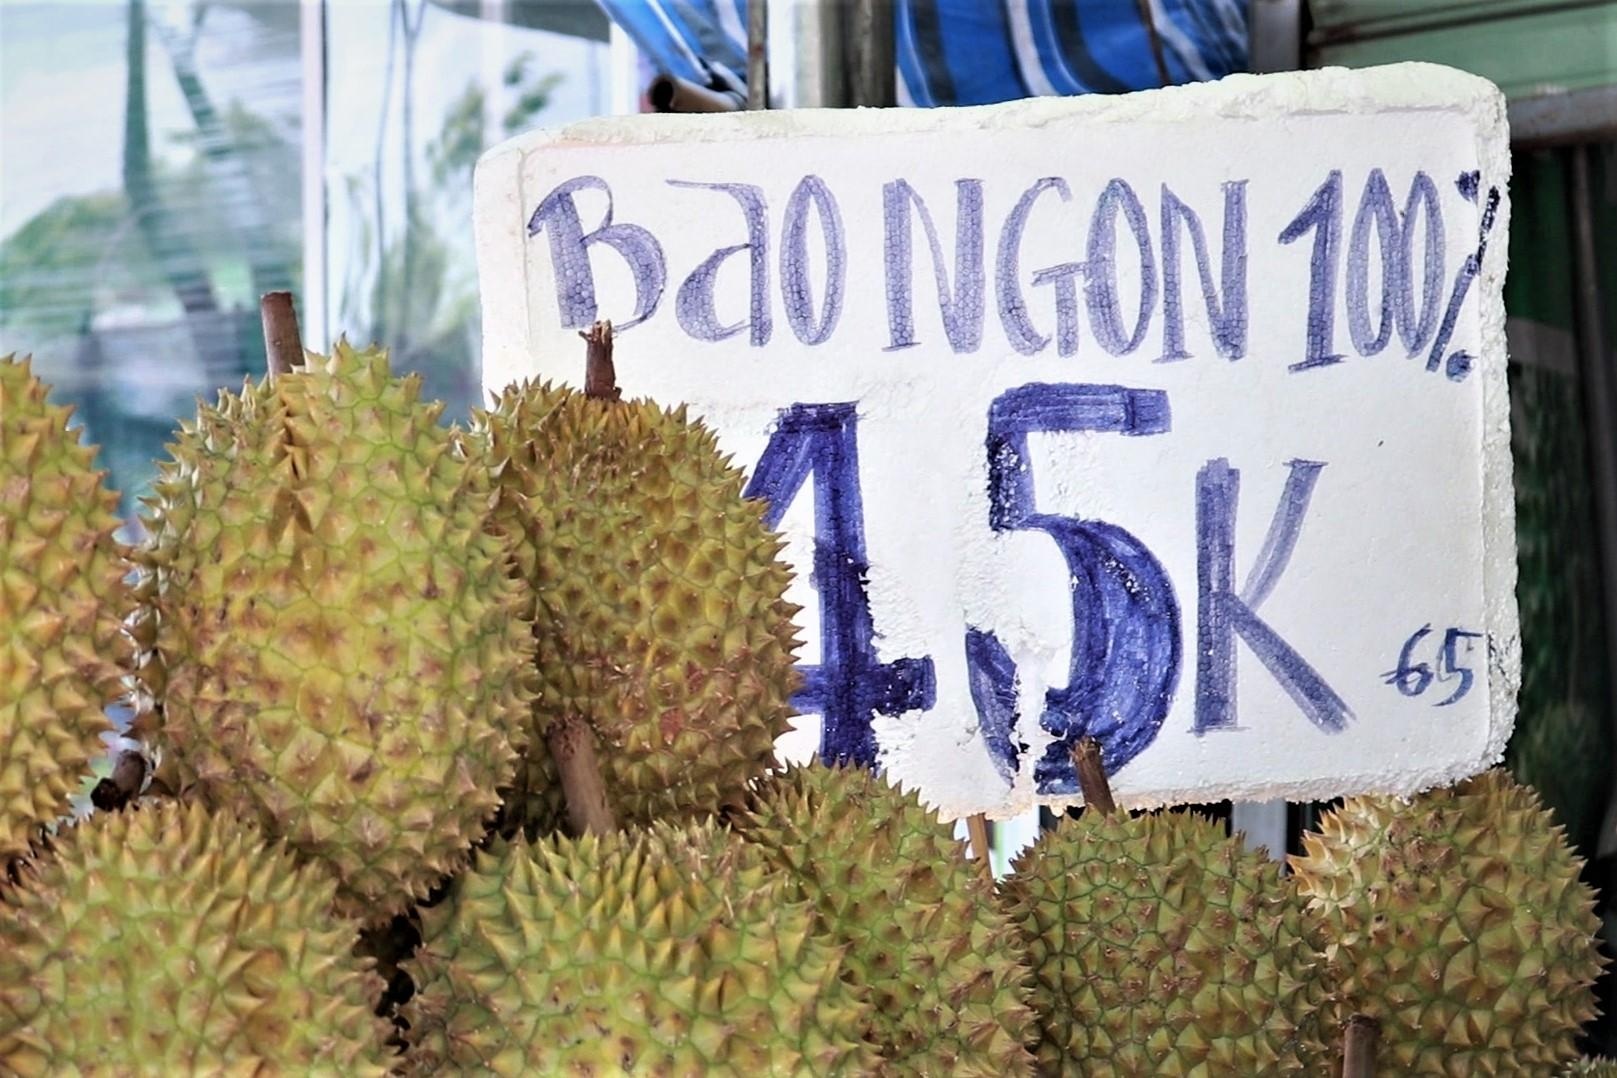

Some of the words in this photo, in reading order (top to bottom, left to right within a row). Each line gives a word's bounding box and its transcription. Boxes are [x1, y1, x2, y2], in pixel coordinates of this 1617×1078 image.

[881, 176, 1249, 363] NGON
[1277, 167, 1501, 383] 100%
[1379, 622, 1484, 707] 65
